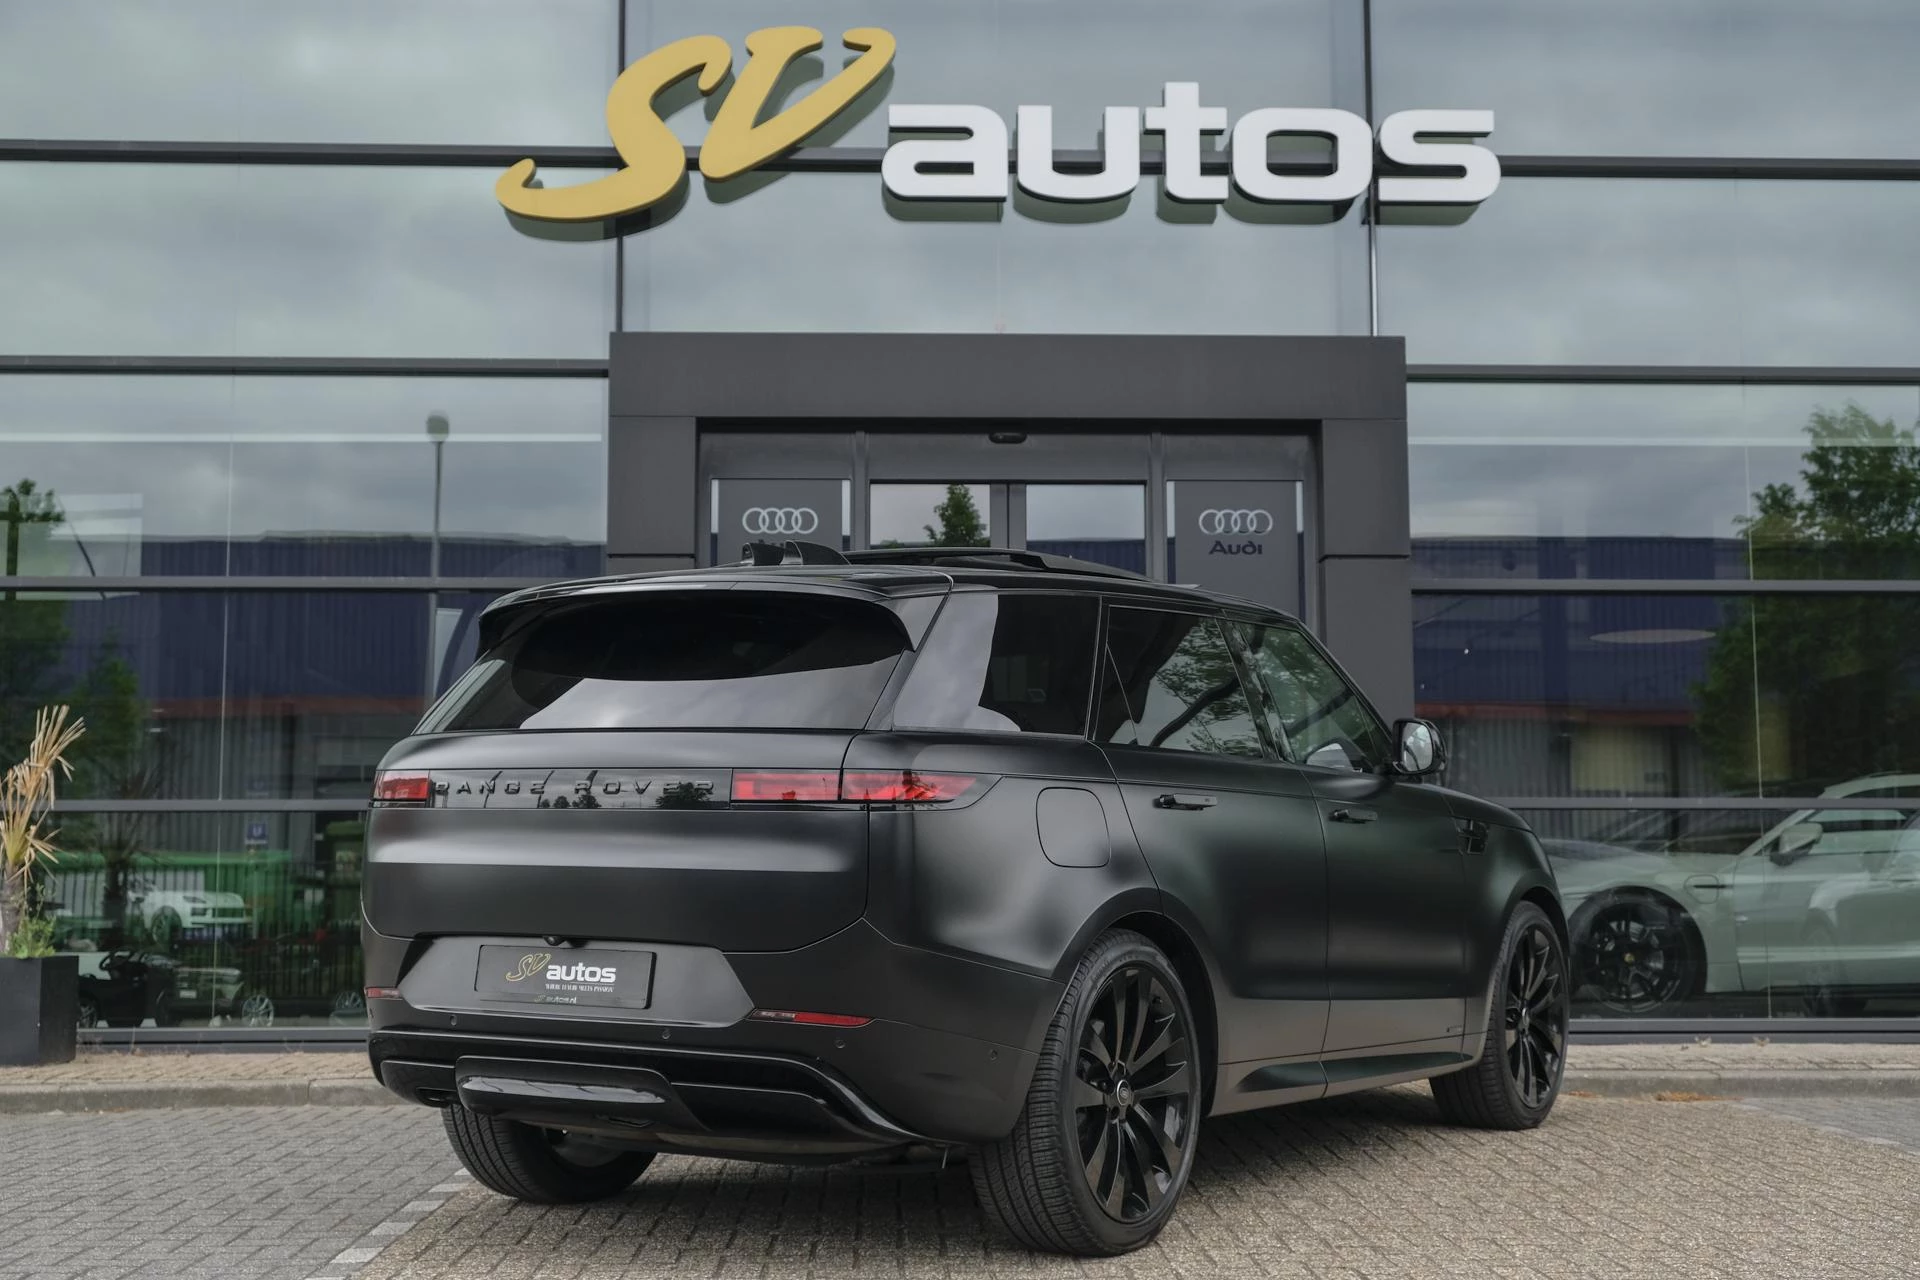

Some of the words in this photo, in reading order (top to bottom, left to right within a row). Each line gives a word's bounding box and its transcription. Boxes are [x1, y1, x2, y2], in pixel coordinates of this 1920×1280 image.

[494, 26, 897, 221] SV
[880, 81, 1502, 203] autos
[1208, 539, 1264, 555] Audi
[434, 780, 546, 795] RANGE
[573, 779, 715, 796] ROVER
[546, 962, 617, 983] autos
